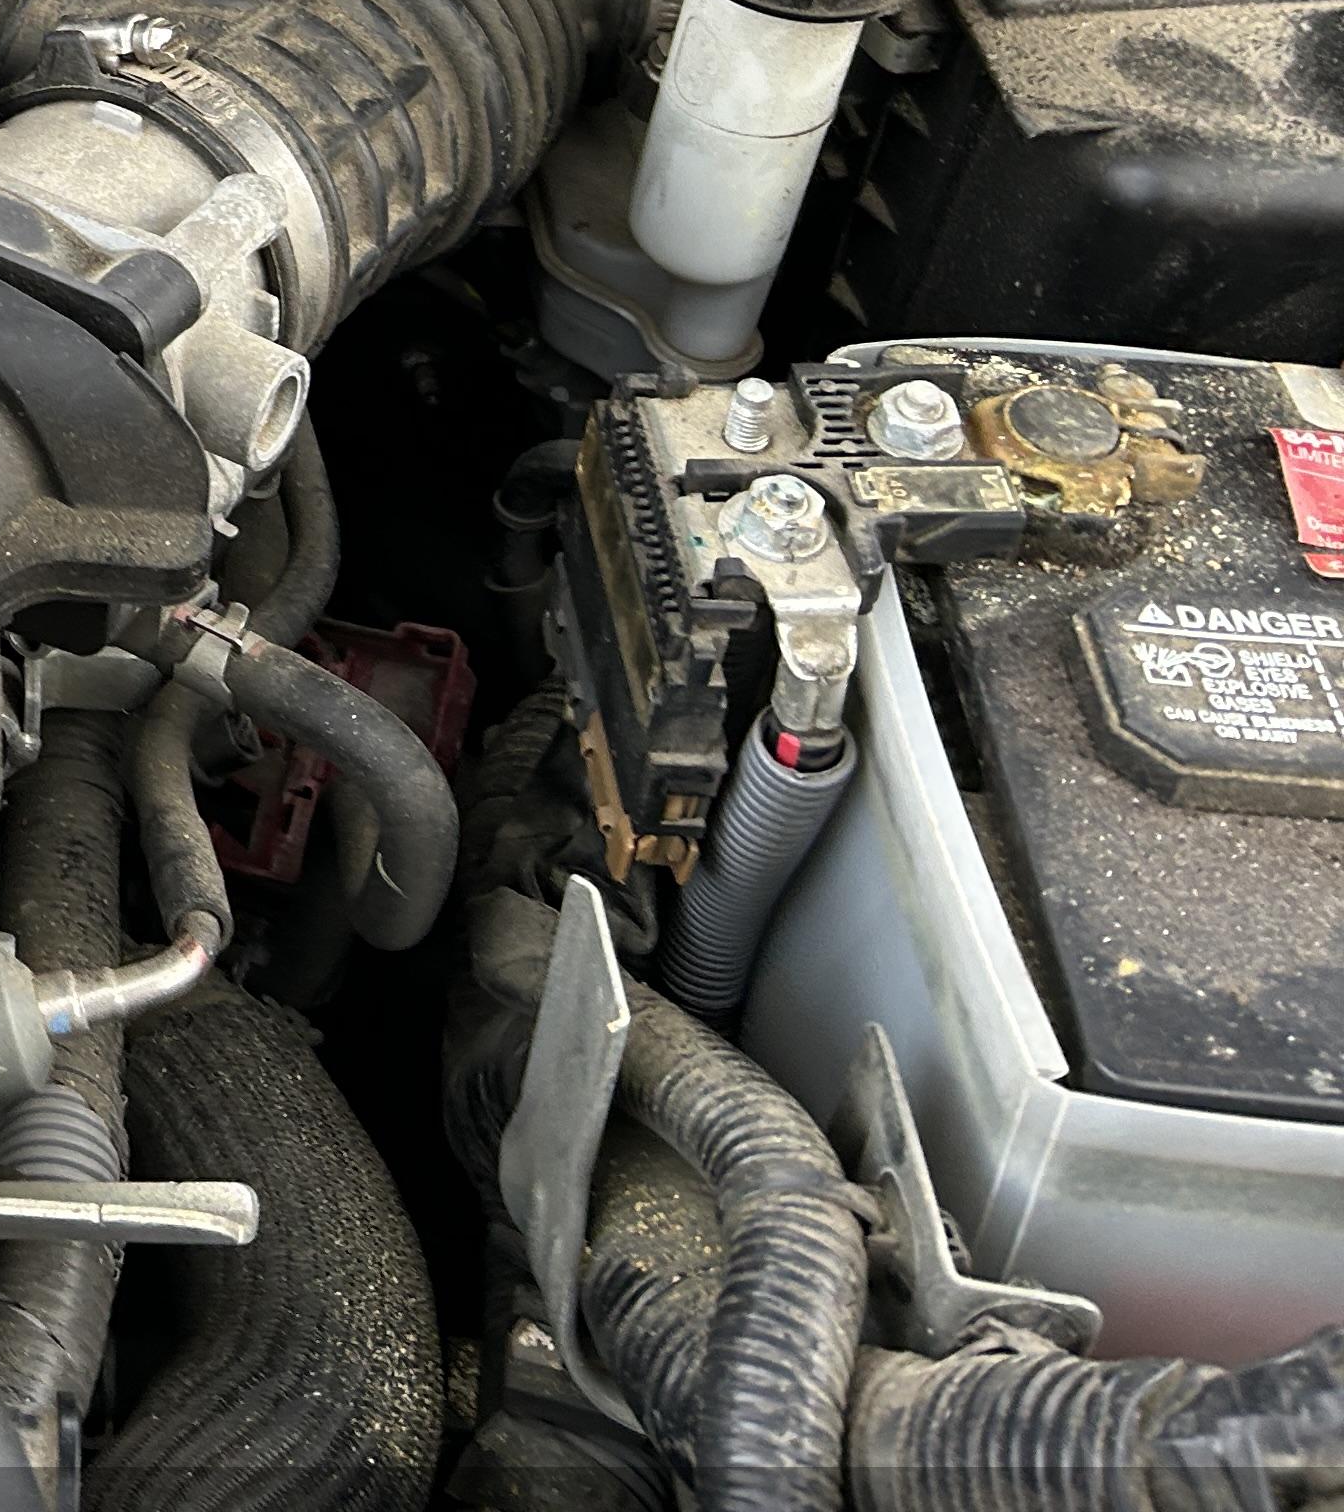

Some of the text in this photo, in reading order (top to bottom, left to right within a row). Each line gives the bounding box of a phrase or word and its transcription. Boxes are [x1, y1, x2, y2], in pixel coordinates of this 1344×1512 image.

[1176, 605, 1344, 638] DANGER
[1238, 649, 1312, 669] SHIELD
[1244, 667, 1299, 684] EYES
[1202, 678, 1313, 700] EXPLOSIVE
[1208, 694, 1276, 714] GASES
[1163, 706, 1336, 733] CAN CAUSE BLINDNESS
[1214, 725, 1298, 744] OR INJURY
